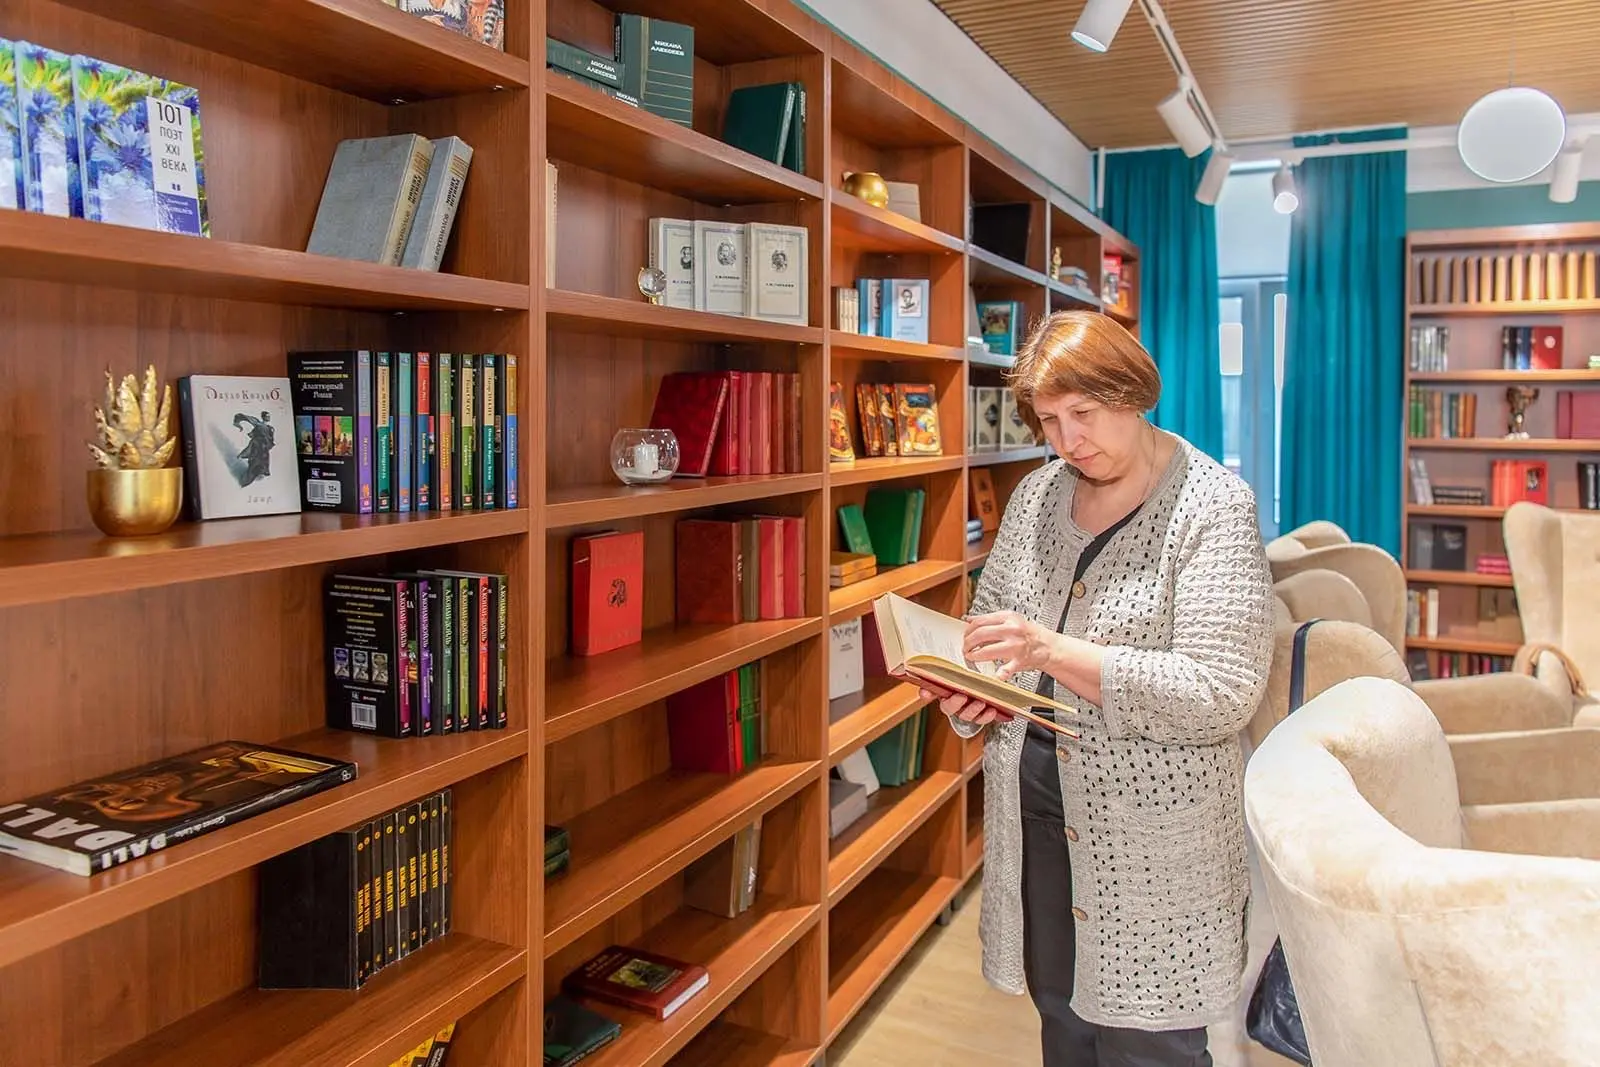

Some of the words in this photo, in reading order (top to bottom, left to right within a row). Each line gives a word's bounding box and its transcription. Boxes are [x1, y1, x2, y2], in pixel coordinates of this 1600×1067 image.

[156, 102, 182, 126] 101
[160, 126, 183, 141] ПОЭТ
[165, 142, 181, 157] XXI
[162, 158, 188, 173] ВЕКА
[101, 833, 168, 870] DALI
